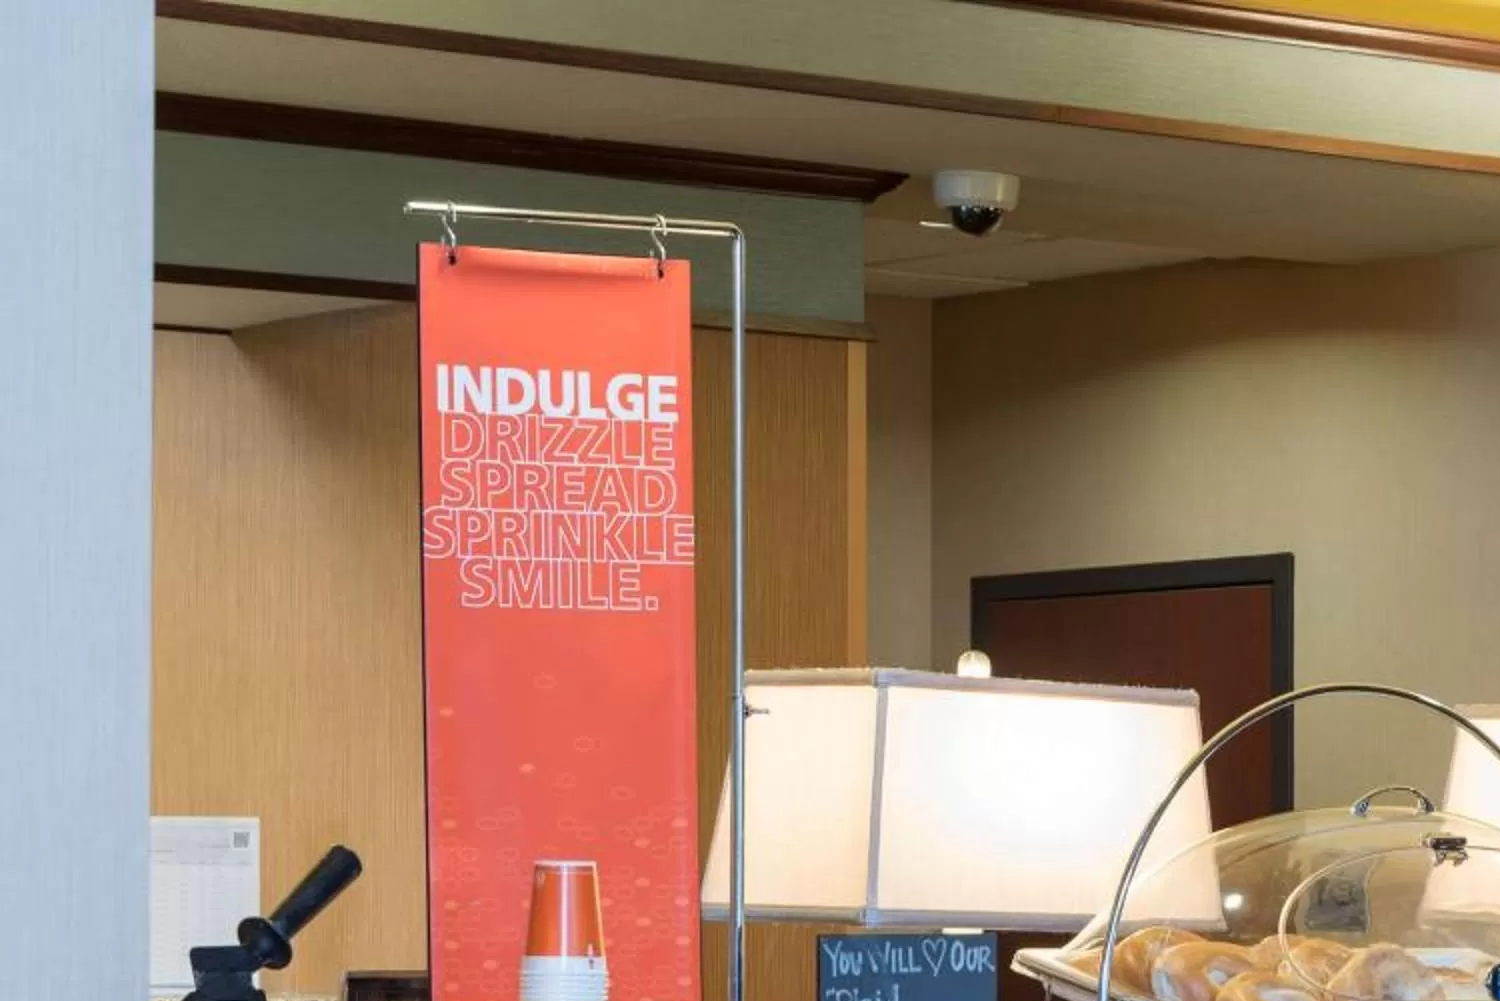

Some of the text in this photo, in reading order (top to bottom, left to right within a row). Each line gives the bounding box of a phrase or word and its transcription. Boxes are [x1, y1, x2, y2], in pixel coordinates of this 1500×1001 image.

[436, 363, 679, 423] INDULGE
[440, 411, 676, 470] DRIZZLE
[440, 459, 677, 517] SPREAD
[423, 505, 695, 565] SPRINKLE
[460, 555, 659, 611] SMILE.
